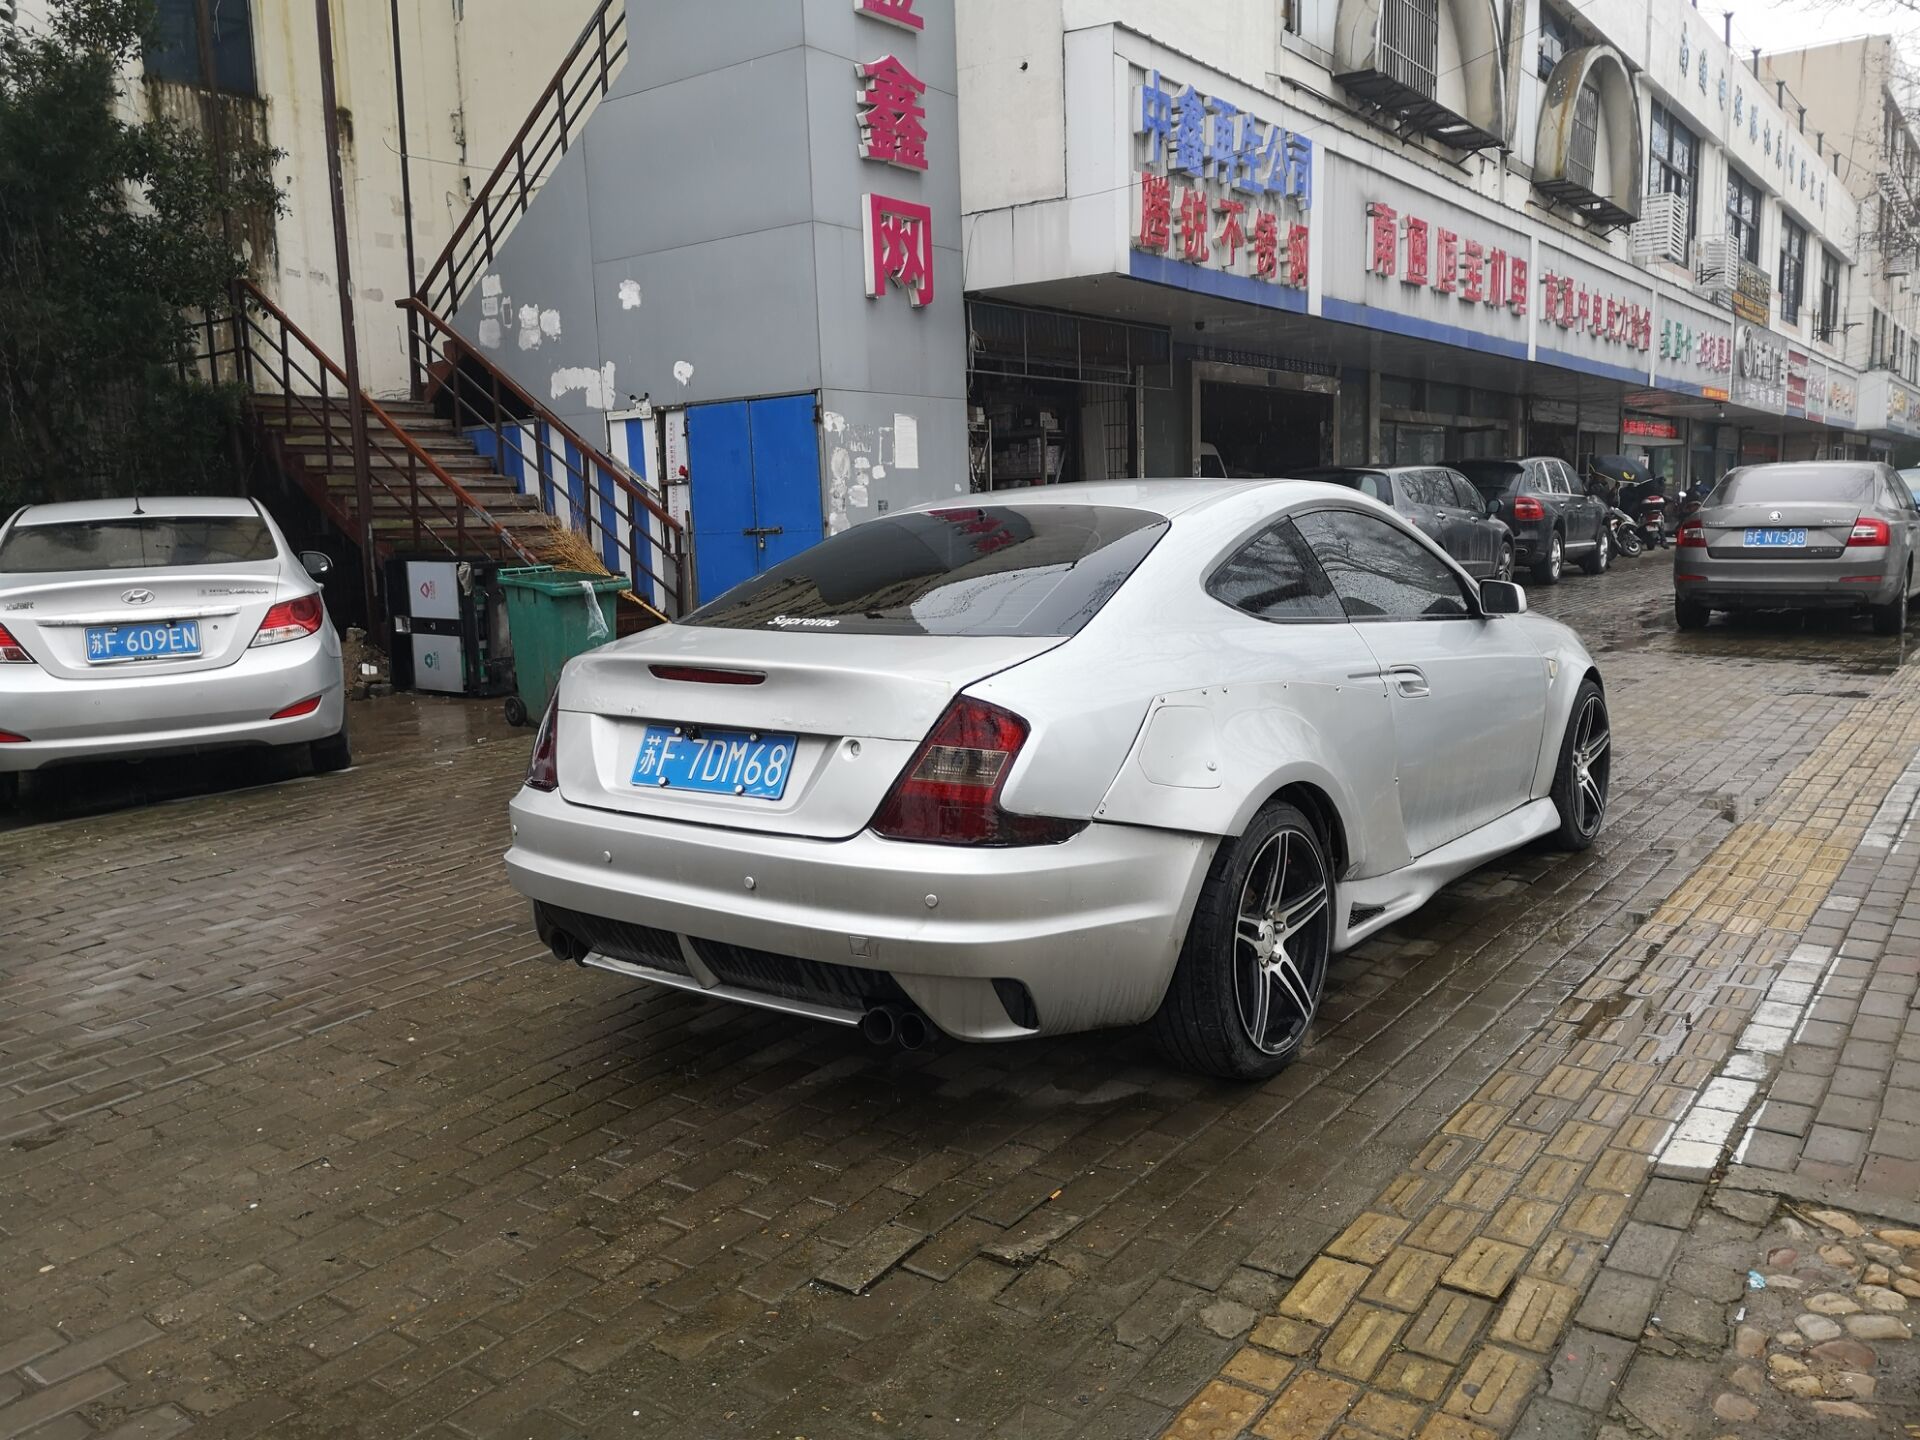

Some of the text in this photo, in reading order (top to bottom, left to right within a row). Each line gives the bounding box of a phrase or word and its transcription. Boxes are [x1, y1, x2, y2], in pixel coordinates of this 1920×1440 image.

[854, 0, 934, 308] 鑫网
[1135, 69, 1312, 211] 中鑫再生公司
[1133, 171, 1309, 288] 腾锐不锈钢
[767, 615, 840, 628] Supreme
